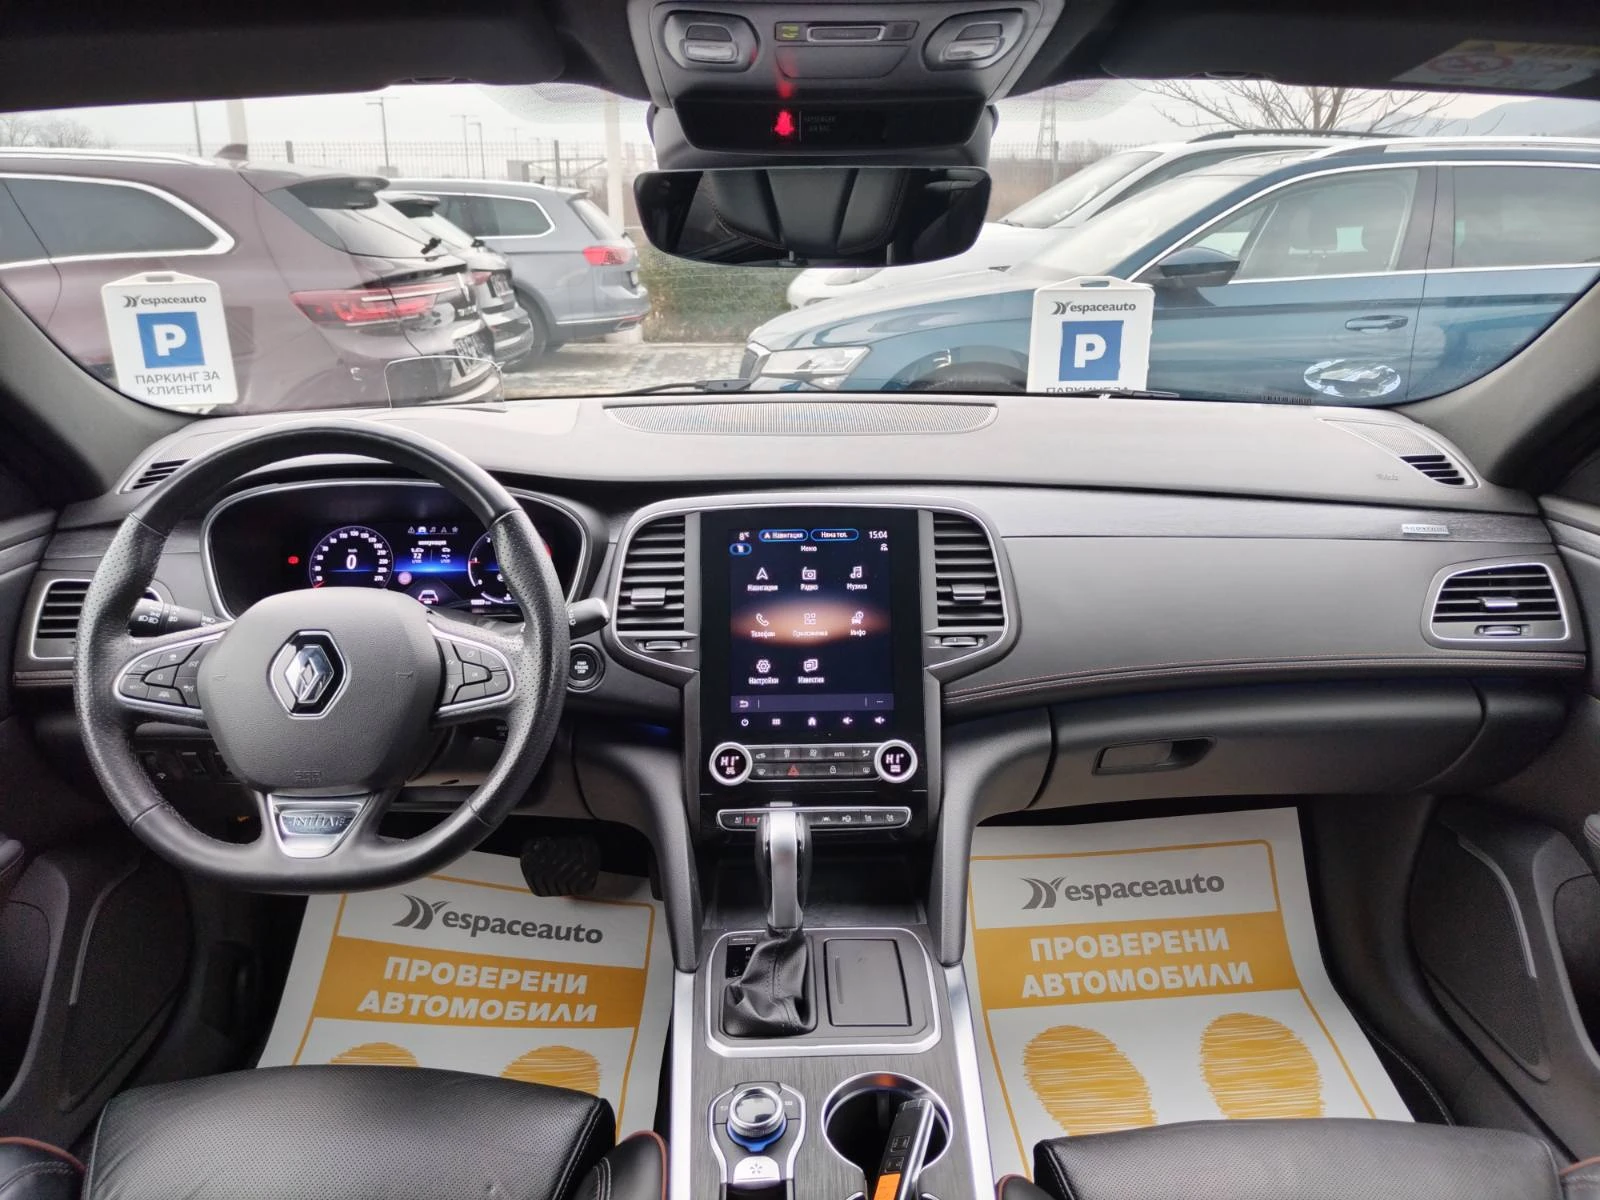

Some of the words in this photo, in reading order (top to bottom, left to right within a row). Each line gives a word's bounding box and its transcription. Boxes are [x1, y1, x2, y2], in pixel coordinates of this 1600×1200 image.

[141, 295, 206, 307] espaceauto
[1070, 302, 1136, 314] espaceauto
[152, 323, 188, 357] P
[1073, 333, 1107, 369] P
[134, 372, 199, 385] ПАРКИНГ
[202, 370, 221, 381] ЗА
[146, 383, 214, 395] КЛИЕНТИ
[868, 530, 888, 540] 15:04
[346, 554, 357, 570] 0
[800, 583, 819, 592] Радио
[846, 582, 868, 591] Музика
[1065, 873, 1225, 906] espaceauto
[442, 910, 604, 944] espaceauto
[1029, 927, 1230, 962] ПРОВЕРЕНИ
[383, 956, 588, 995] ПРОВЕРЕНИ
[1022, 961, 1254, 999] АВТОМОБИЛИ
[356, 990, 598, 1022] АВТОМОБИЛИ
